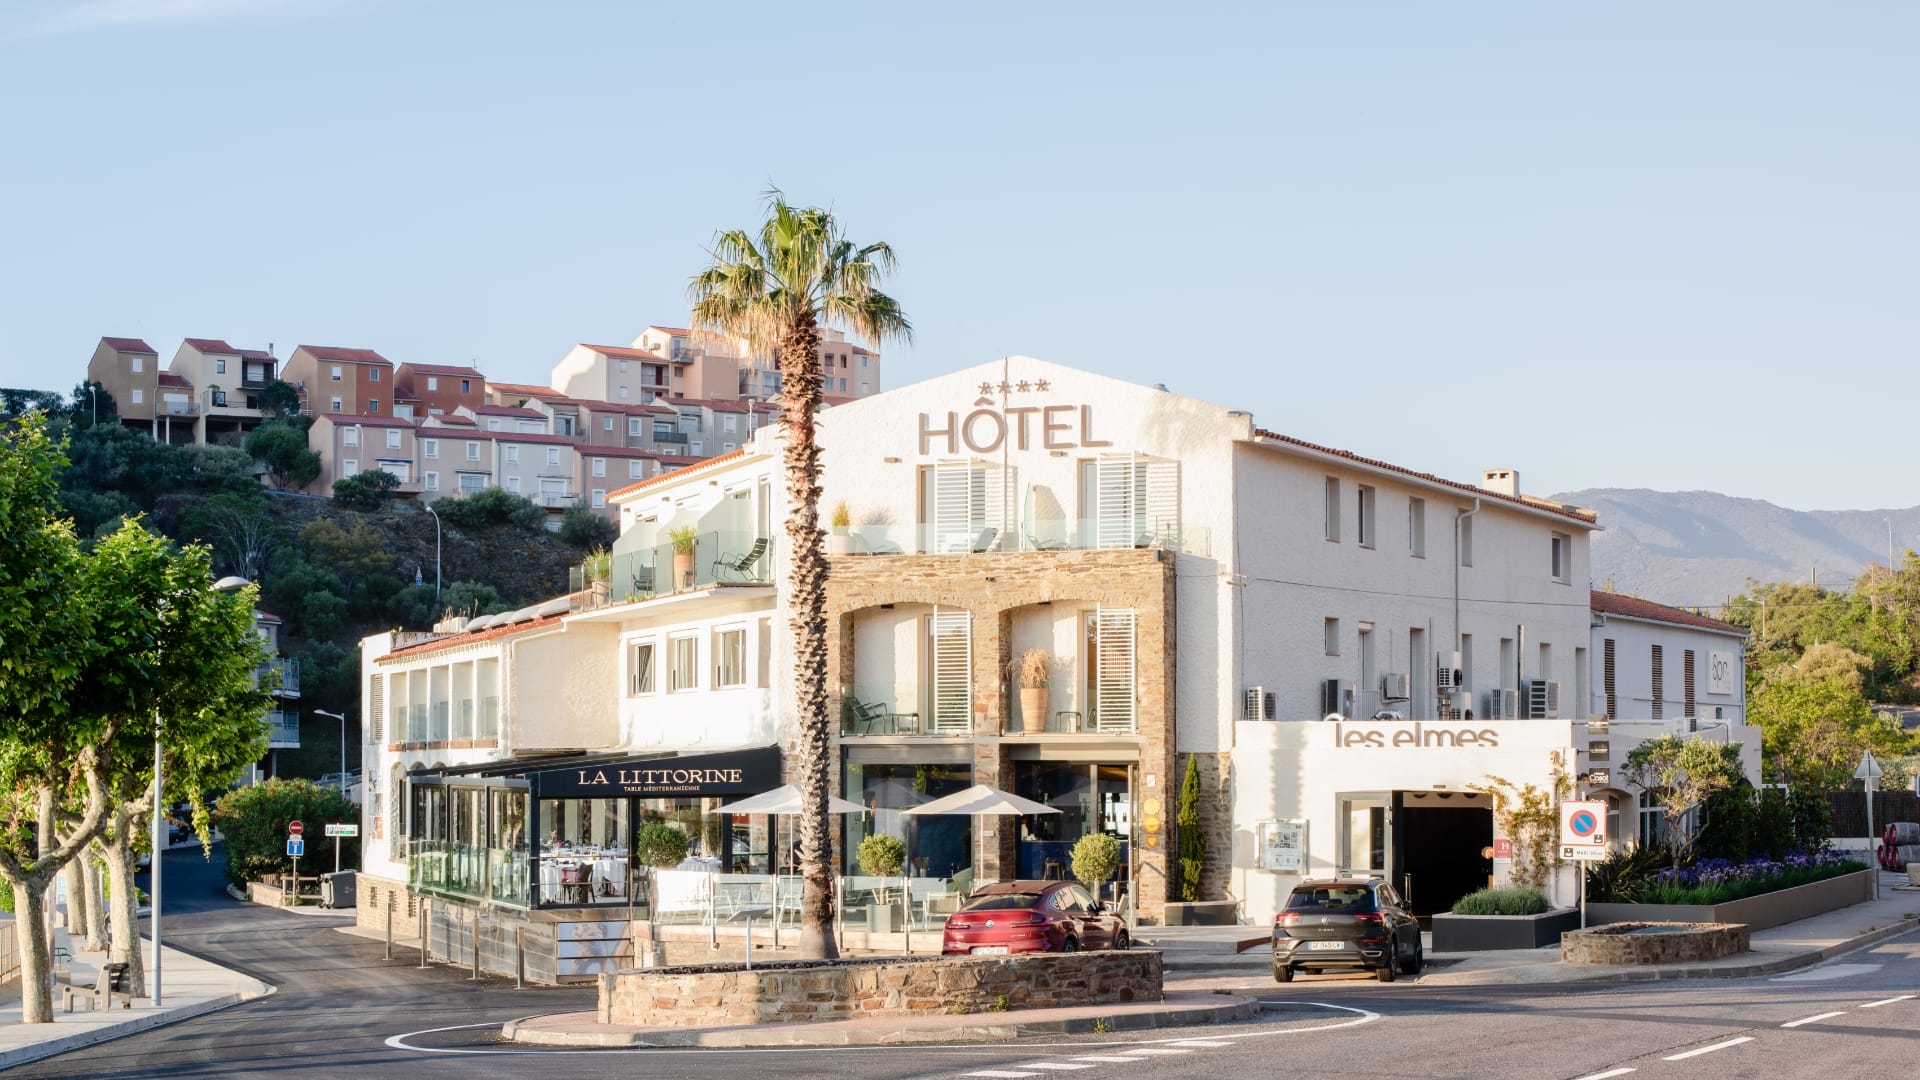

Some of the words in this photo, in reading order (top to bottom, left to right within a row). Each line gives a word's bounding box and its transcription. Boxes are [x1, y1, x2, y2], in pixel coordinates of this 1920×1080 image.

[918, 397, 1112, 456] HÔTEL
[1335, 722, 1385, 748] les
[1392, 721, 1499, 748] elmes
[577, 770, 610, 785] LA
[618, 769, 743, 784] LITTORINE
